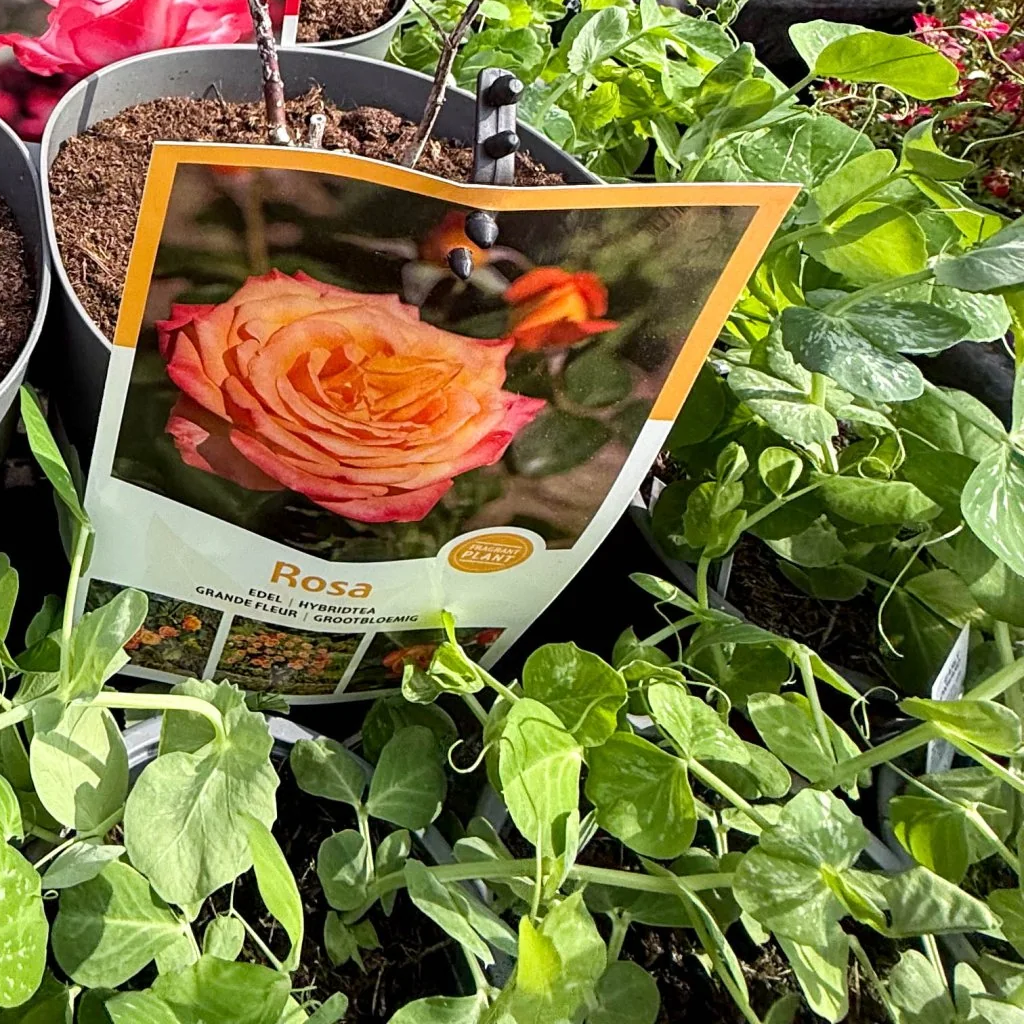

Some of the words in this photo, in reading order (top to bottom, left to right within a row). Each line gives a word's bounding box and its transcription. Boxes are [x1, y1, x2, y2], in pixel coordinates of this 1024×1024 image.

[461, 551, 515, 563] PLANT
[469, 544, 521, 555] FRAGRANT
[270, 560, 373, 599] Rosa
[195, 586, 252, 608] GRANDE
[255, 601, 298, 618] FLEUR
[313, 614, 419, 625] GROOTBLOEMIG
[248, 588, 283, 604] EDEL
[298, 600, 376, 615] HYBRIDTEA
